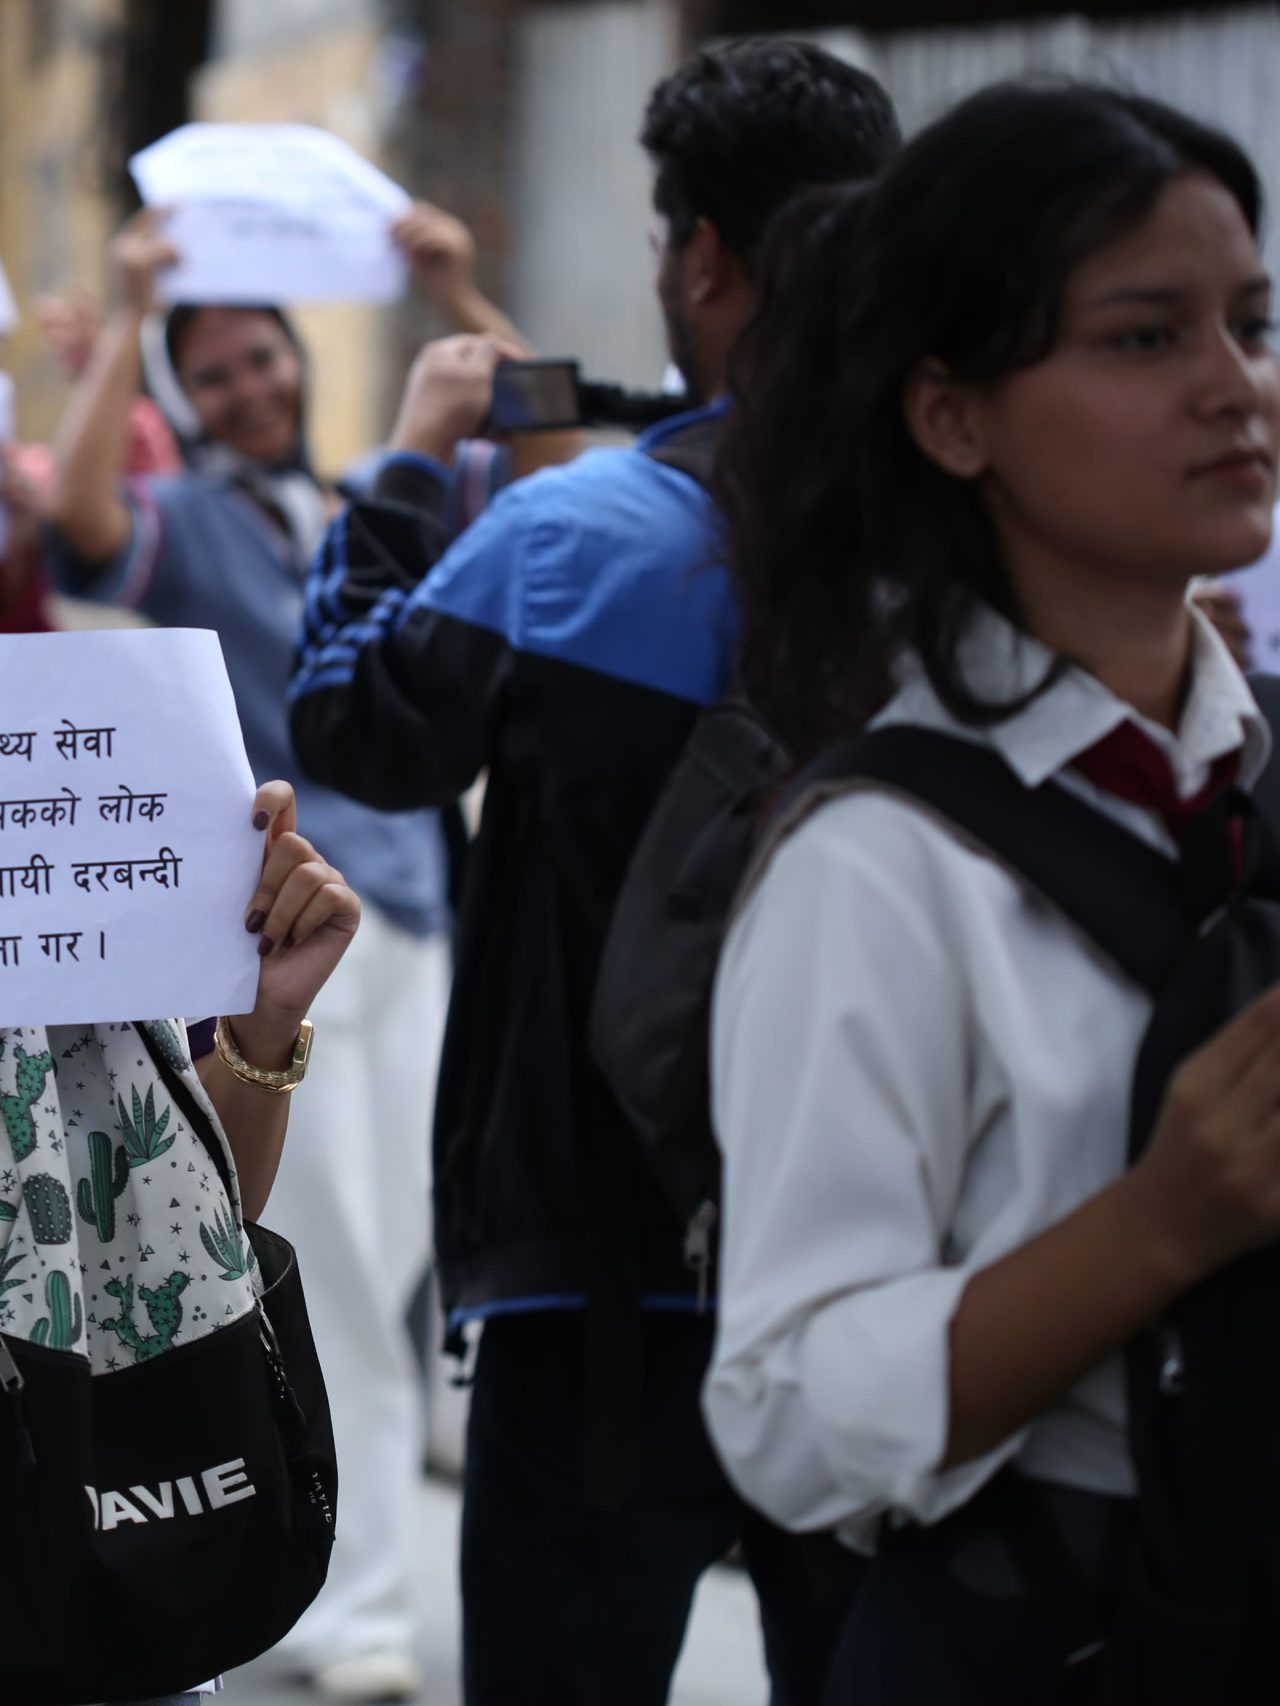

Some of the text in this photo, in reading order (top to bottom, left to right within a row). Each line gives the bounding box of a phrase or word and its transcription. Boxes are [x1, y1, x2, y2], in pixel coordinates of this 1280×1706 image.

[53, 717, 117, 761] सेवा
[97, 783, 168, 824] लोक
[70, 845, 184, 893] दरबन्दी
[37, 930, 84, 963] गर
